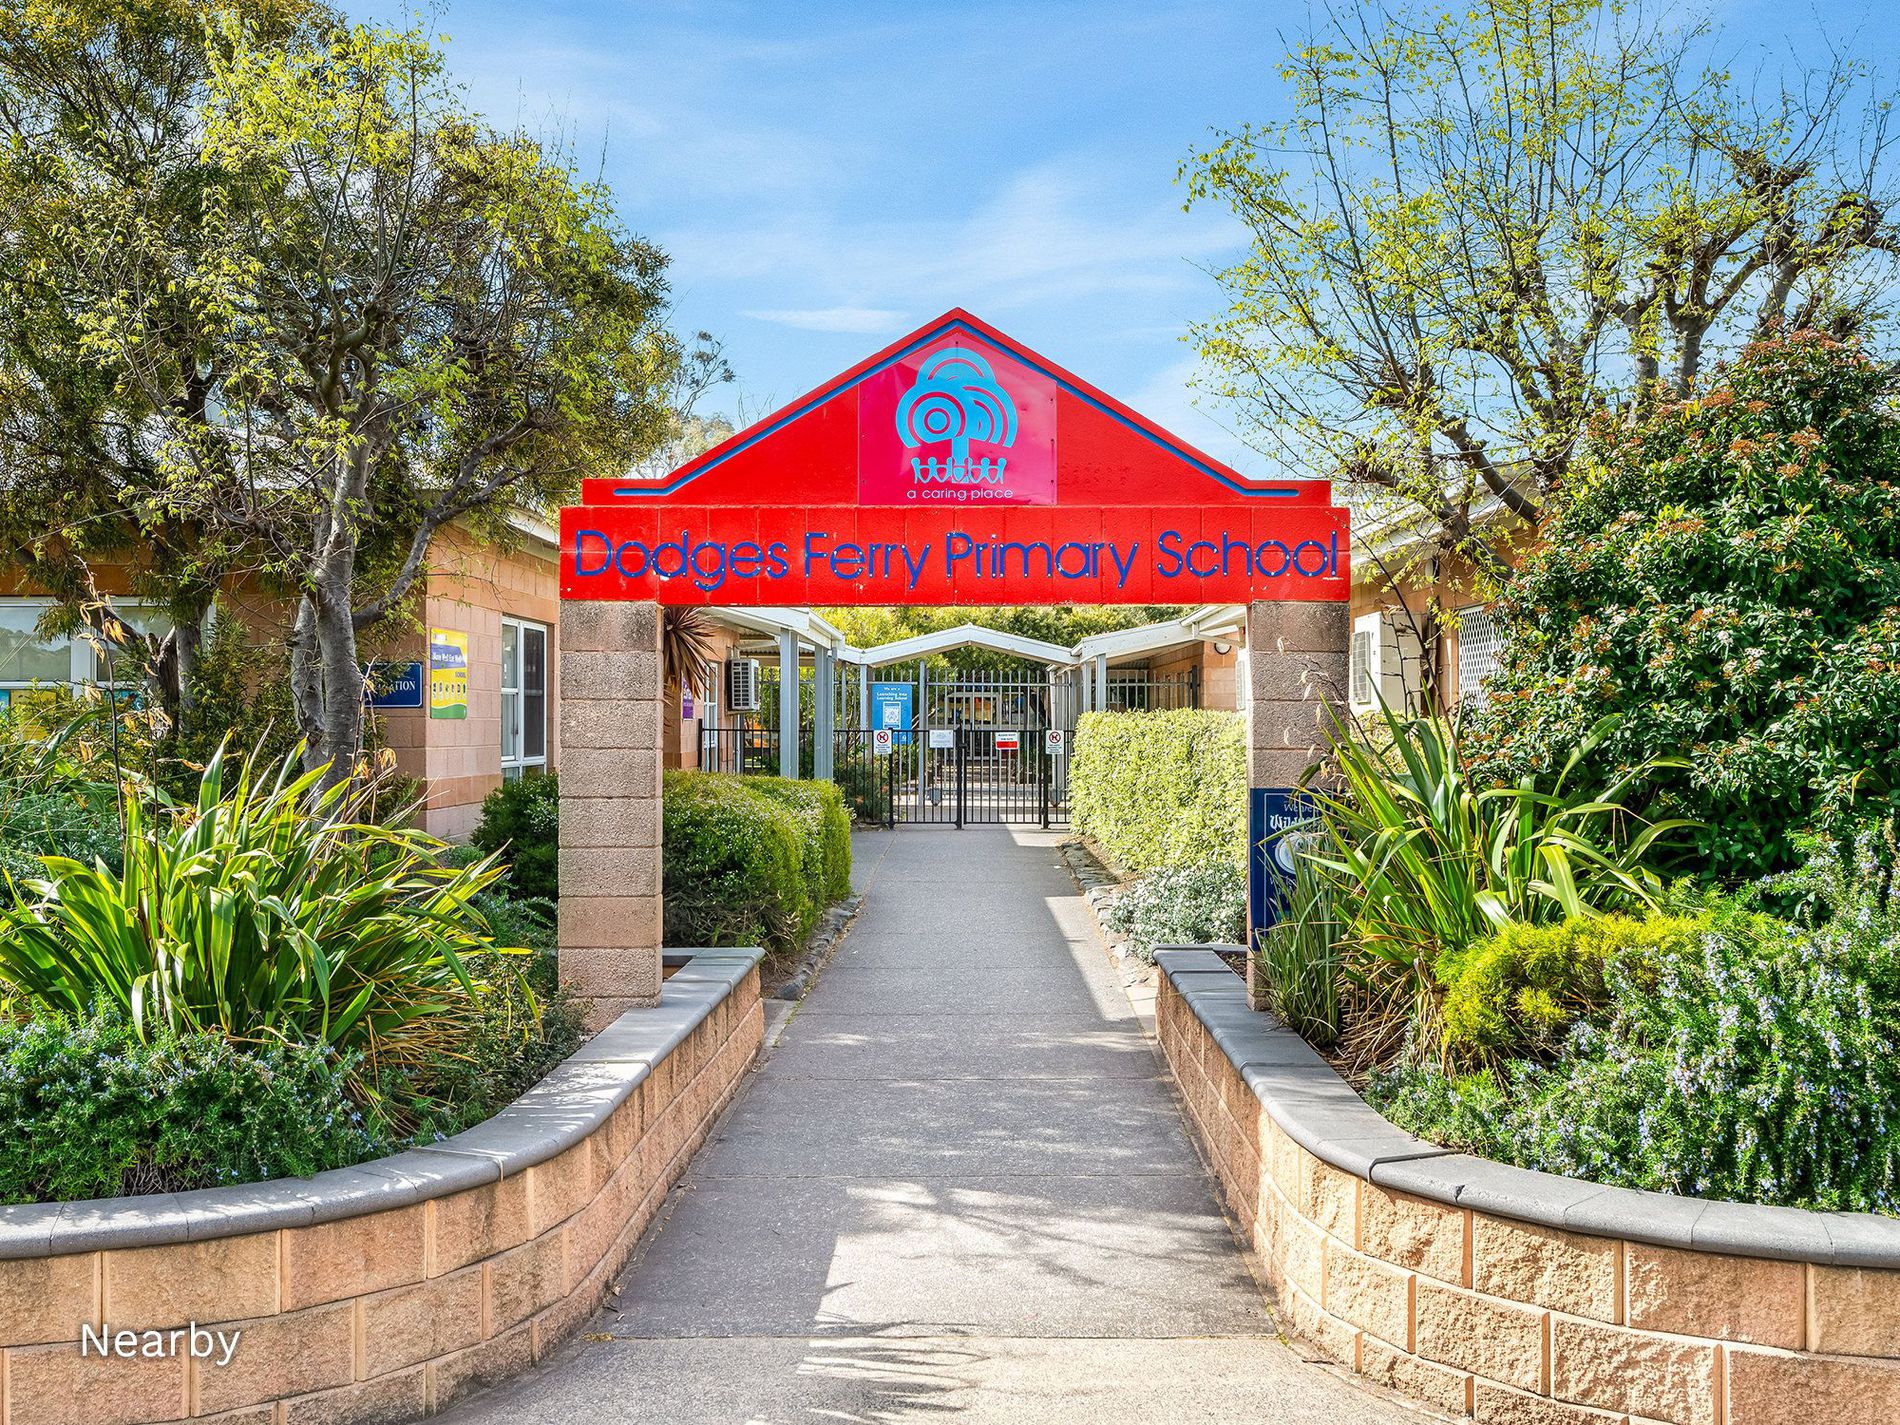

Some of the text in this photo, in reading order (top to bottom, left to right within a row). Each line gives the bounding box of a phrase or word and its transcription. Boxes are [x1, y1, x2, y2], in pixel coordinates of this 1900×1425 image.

[906, 487, 1014, 501] a caring place
[576, 530, 1337, 591] Dodges Ferry Primary School
